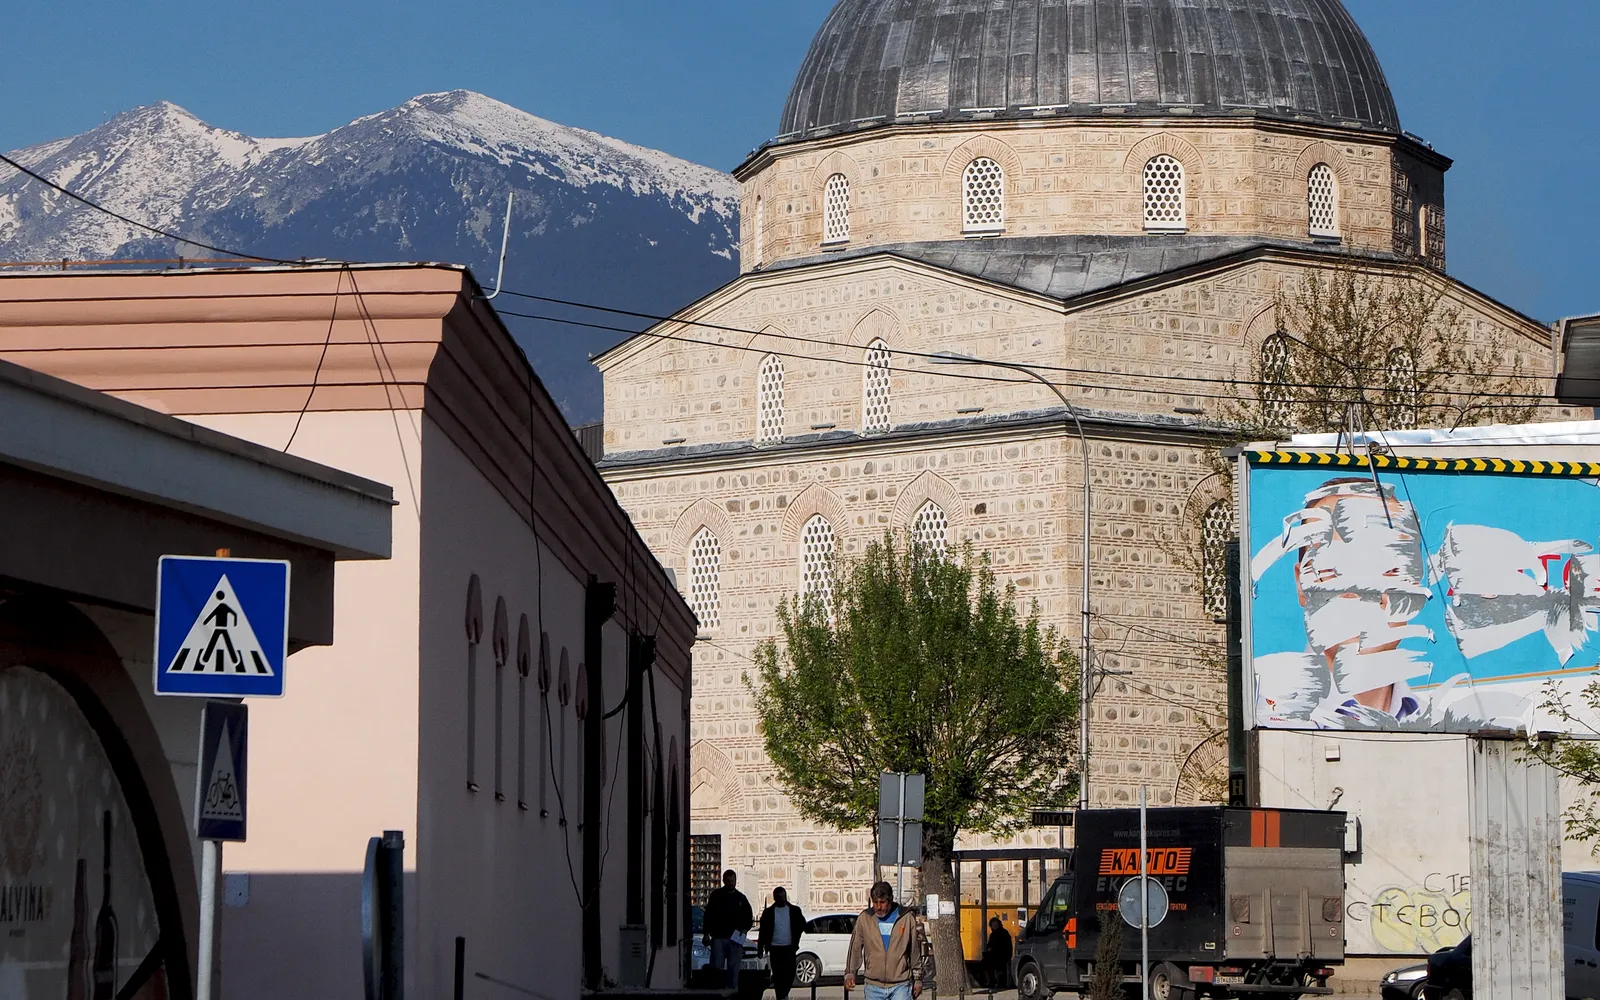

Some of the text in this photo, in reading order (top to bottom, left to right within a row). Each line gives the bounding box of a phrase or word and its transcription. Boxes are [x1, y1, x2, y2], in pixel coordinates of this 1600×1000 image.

[1034, 813, 1072, 825] НОТАР
[1113, 828, 1181, 839] www.kargekspres.mk
[1096, 876, 1188, 892] ЕКЕС
